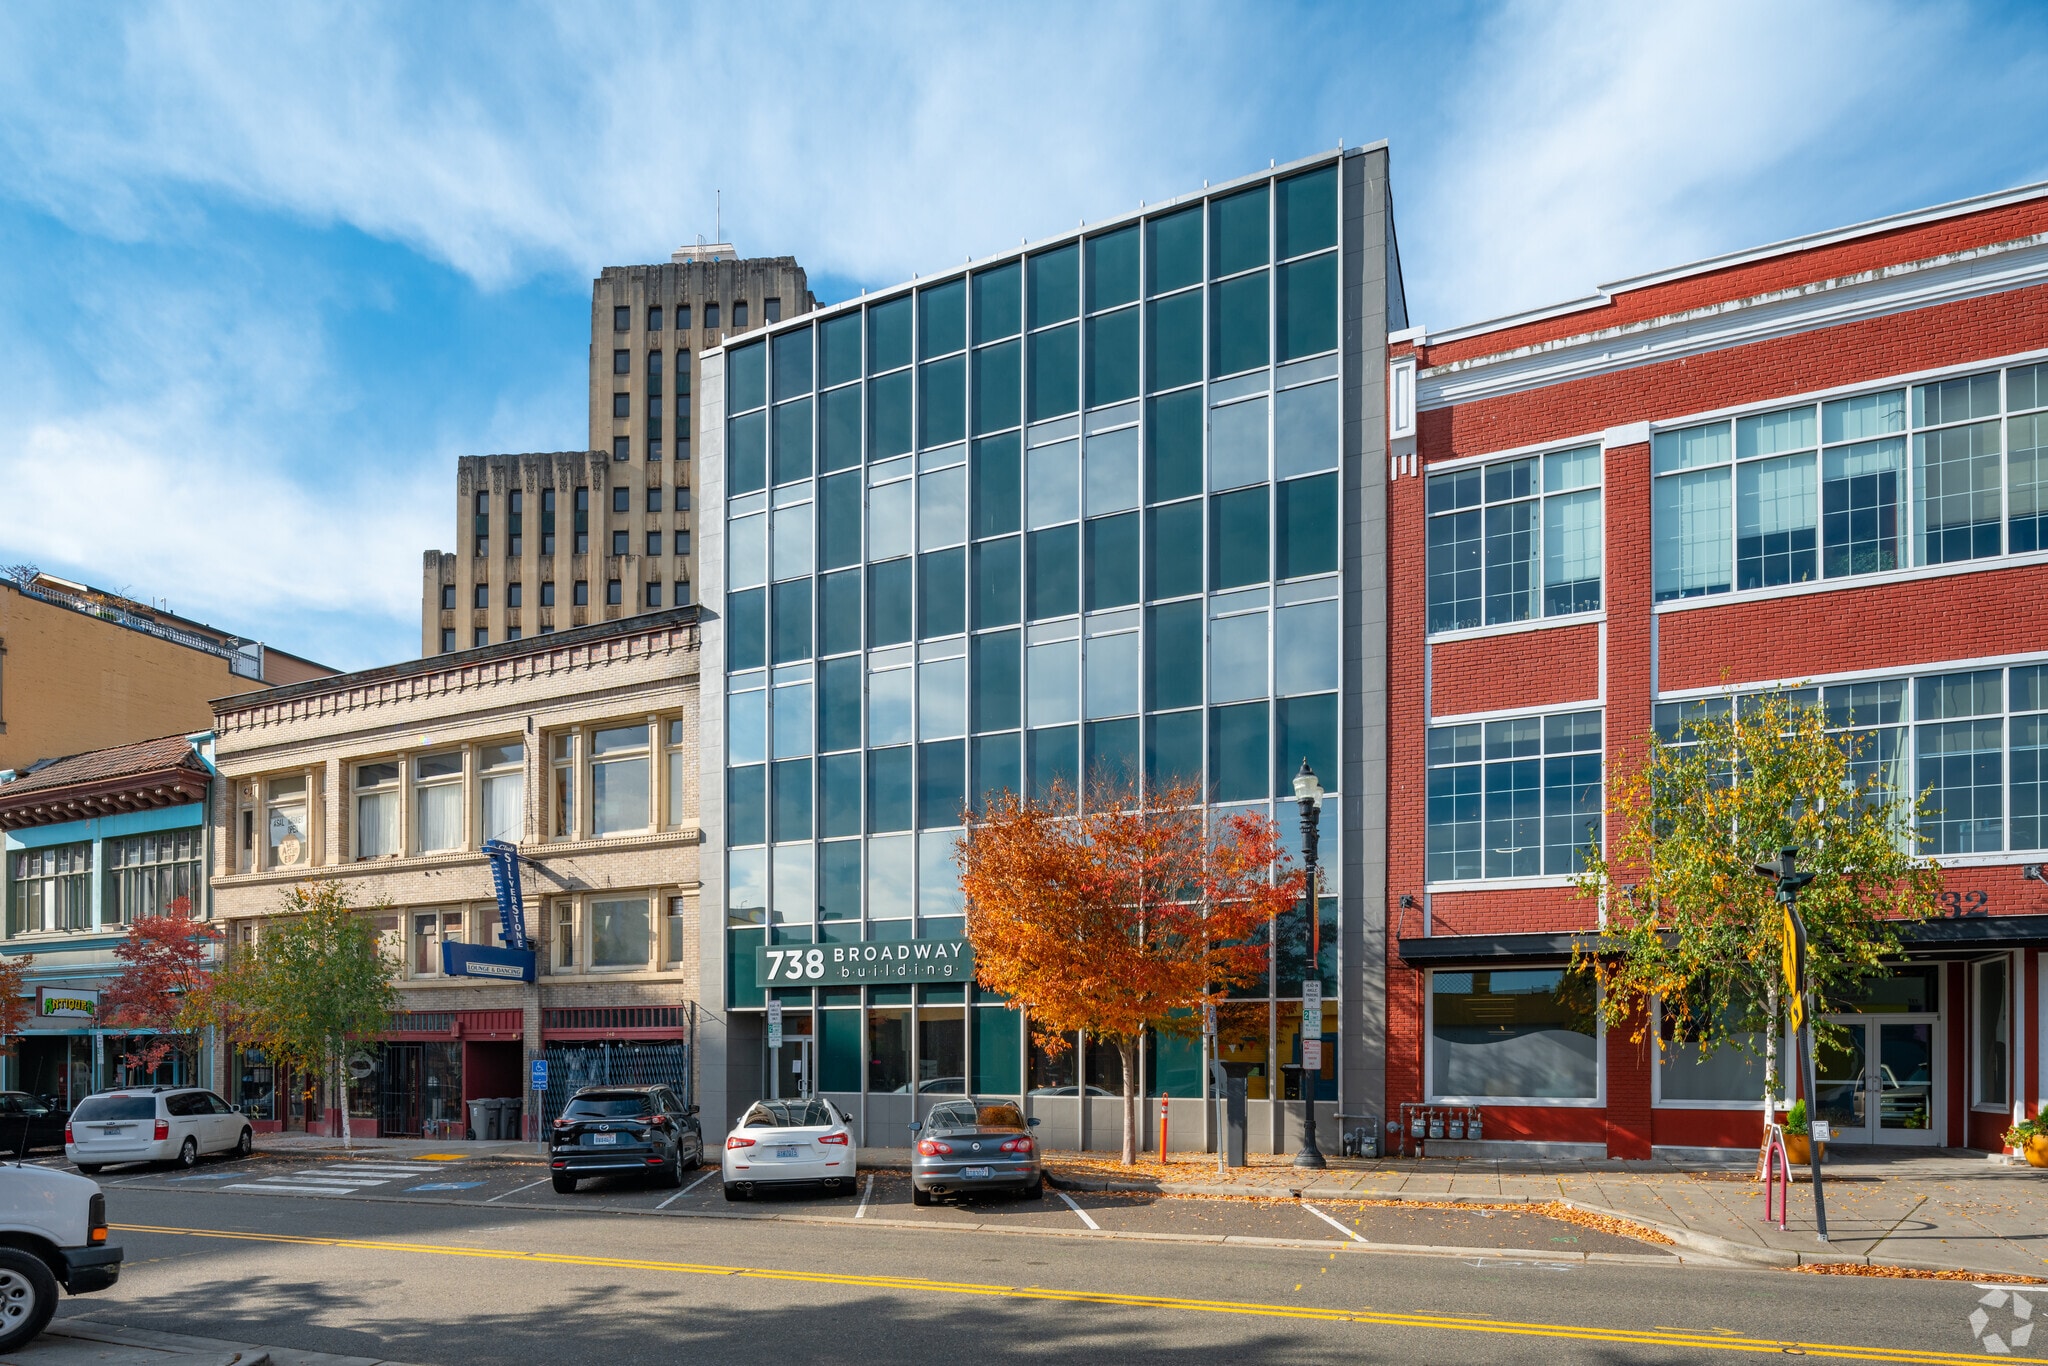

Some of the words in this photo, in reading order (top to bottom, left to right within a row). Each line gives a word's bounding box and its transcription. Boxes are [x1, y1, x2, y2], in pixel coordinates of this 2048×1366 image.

[498, 843, 515, 853] Club
[503, 852, 524, 948] SILVERSTONE
[1917, 890, 1988, 918] 32
[467, 964, 489, 972] LOUNGE
[496, 967, 521, 975] DANCING
[766, 949, 825, 981] 738
[834, 942, 963, 963] BROADWAY
